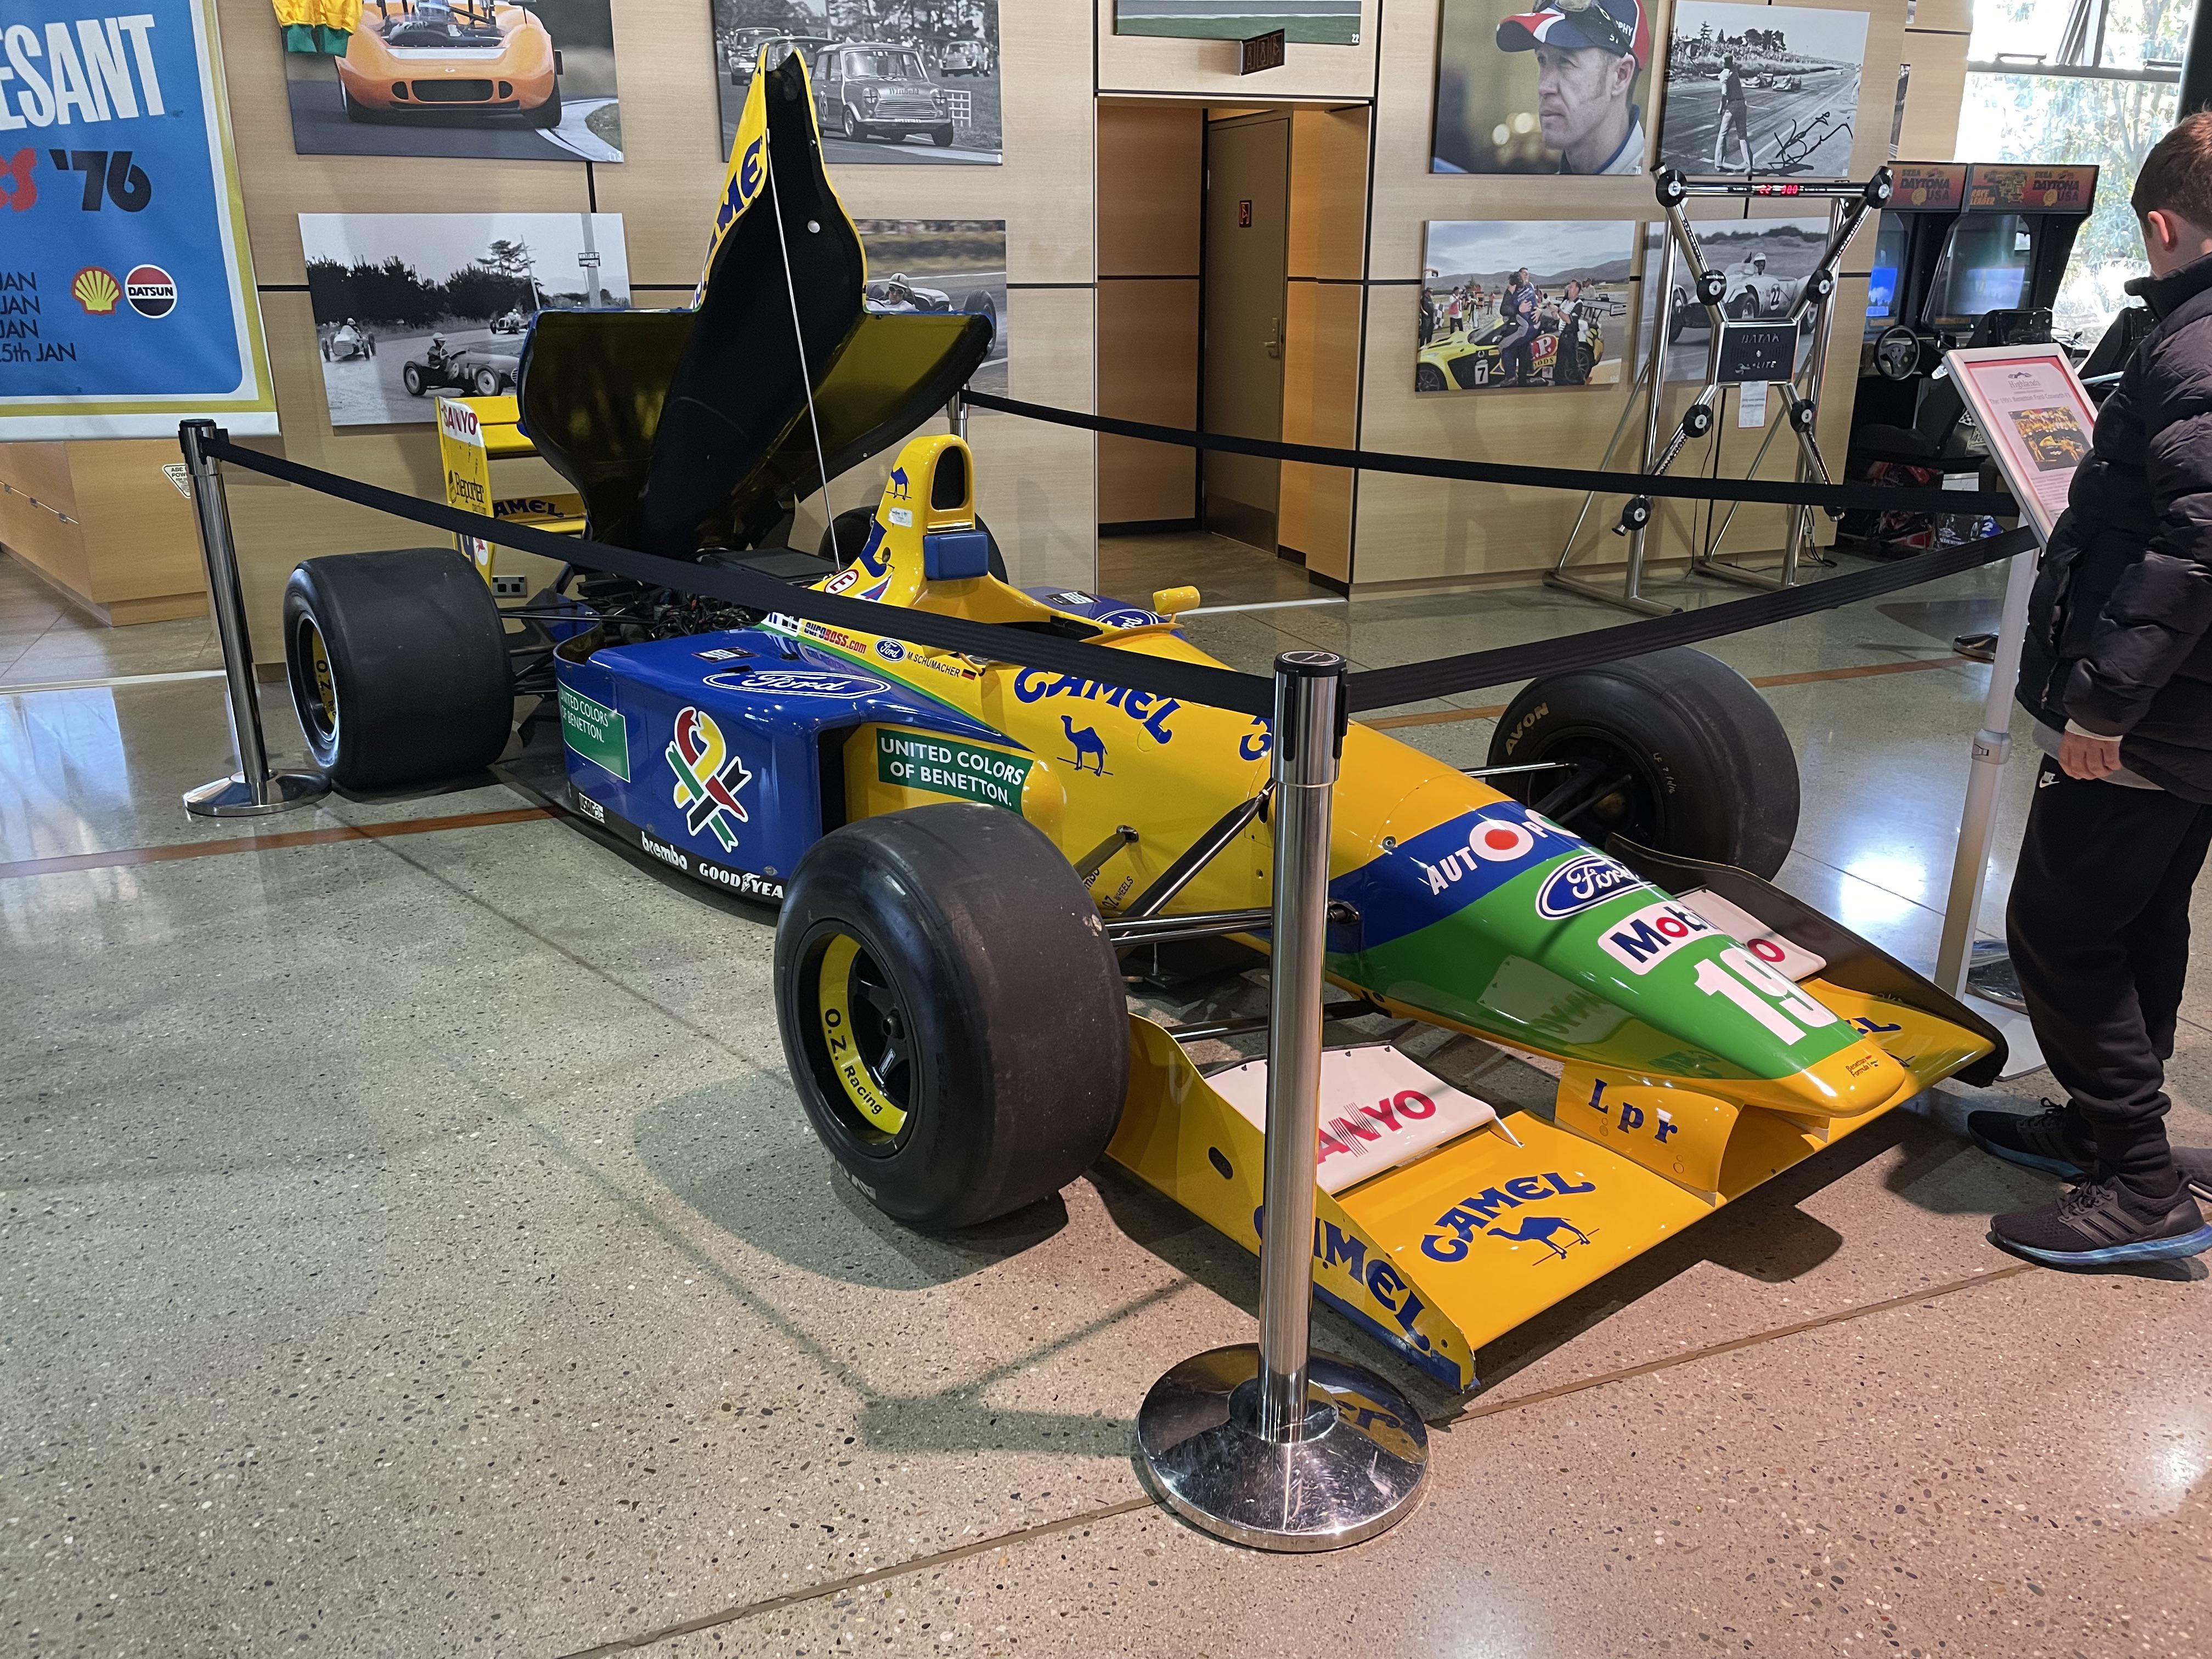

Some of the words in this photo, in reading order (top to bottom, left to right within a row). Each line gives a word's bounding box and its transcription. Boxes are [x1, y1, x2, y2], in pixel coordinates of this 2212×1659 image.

[48, 149, 152, 212] '76
[1, 294, 41, 315] JAN
[128, 286, 174, 296] DATSUN
[36, 342, 77, 362] JAN
[1477, 366, 1486, 382] 7
[2008, 379, 2041, 389] Highlands
[442, 404, 478, 436] SANYO
[493, 499, 565, 518] AMEL
[879, 641, 902, 658] Ford
[742, 672, 853, 692] Ford
[580, 701, 608, 727] COLORS
[1505, 702, 1549, 756] AVON
[881, 737, 957, 764] UNITED
[957, 752, 1024, 786] COLORS
[890, 761, 916, 779] OF
[921, 766, 1012, 806] BENETTON.
[641, 831, 688, 871] brembo
[699, 862, 784, 899] GOODYEA
[1693, 941, 1838, 1046] 19
[844, 1065, 883, 1115] Racing
[1318, 1089, 1436, 1165] ANYO
[1421, 1171, 1596, 1263] CAMEL
[1254, 1205, 1430, 1351] MEL
